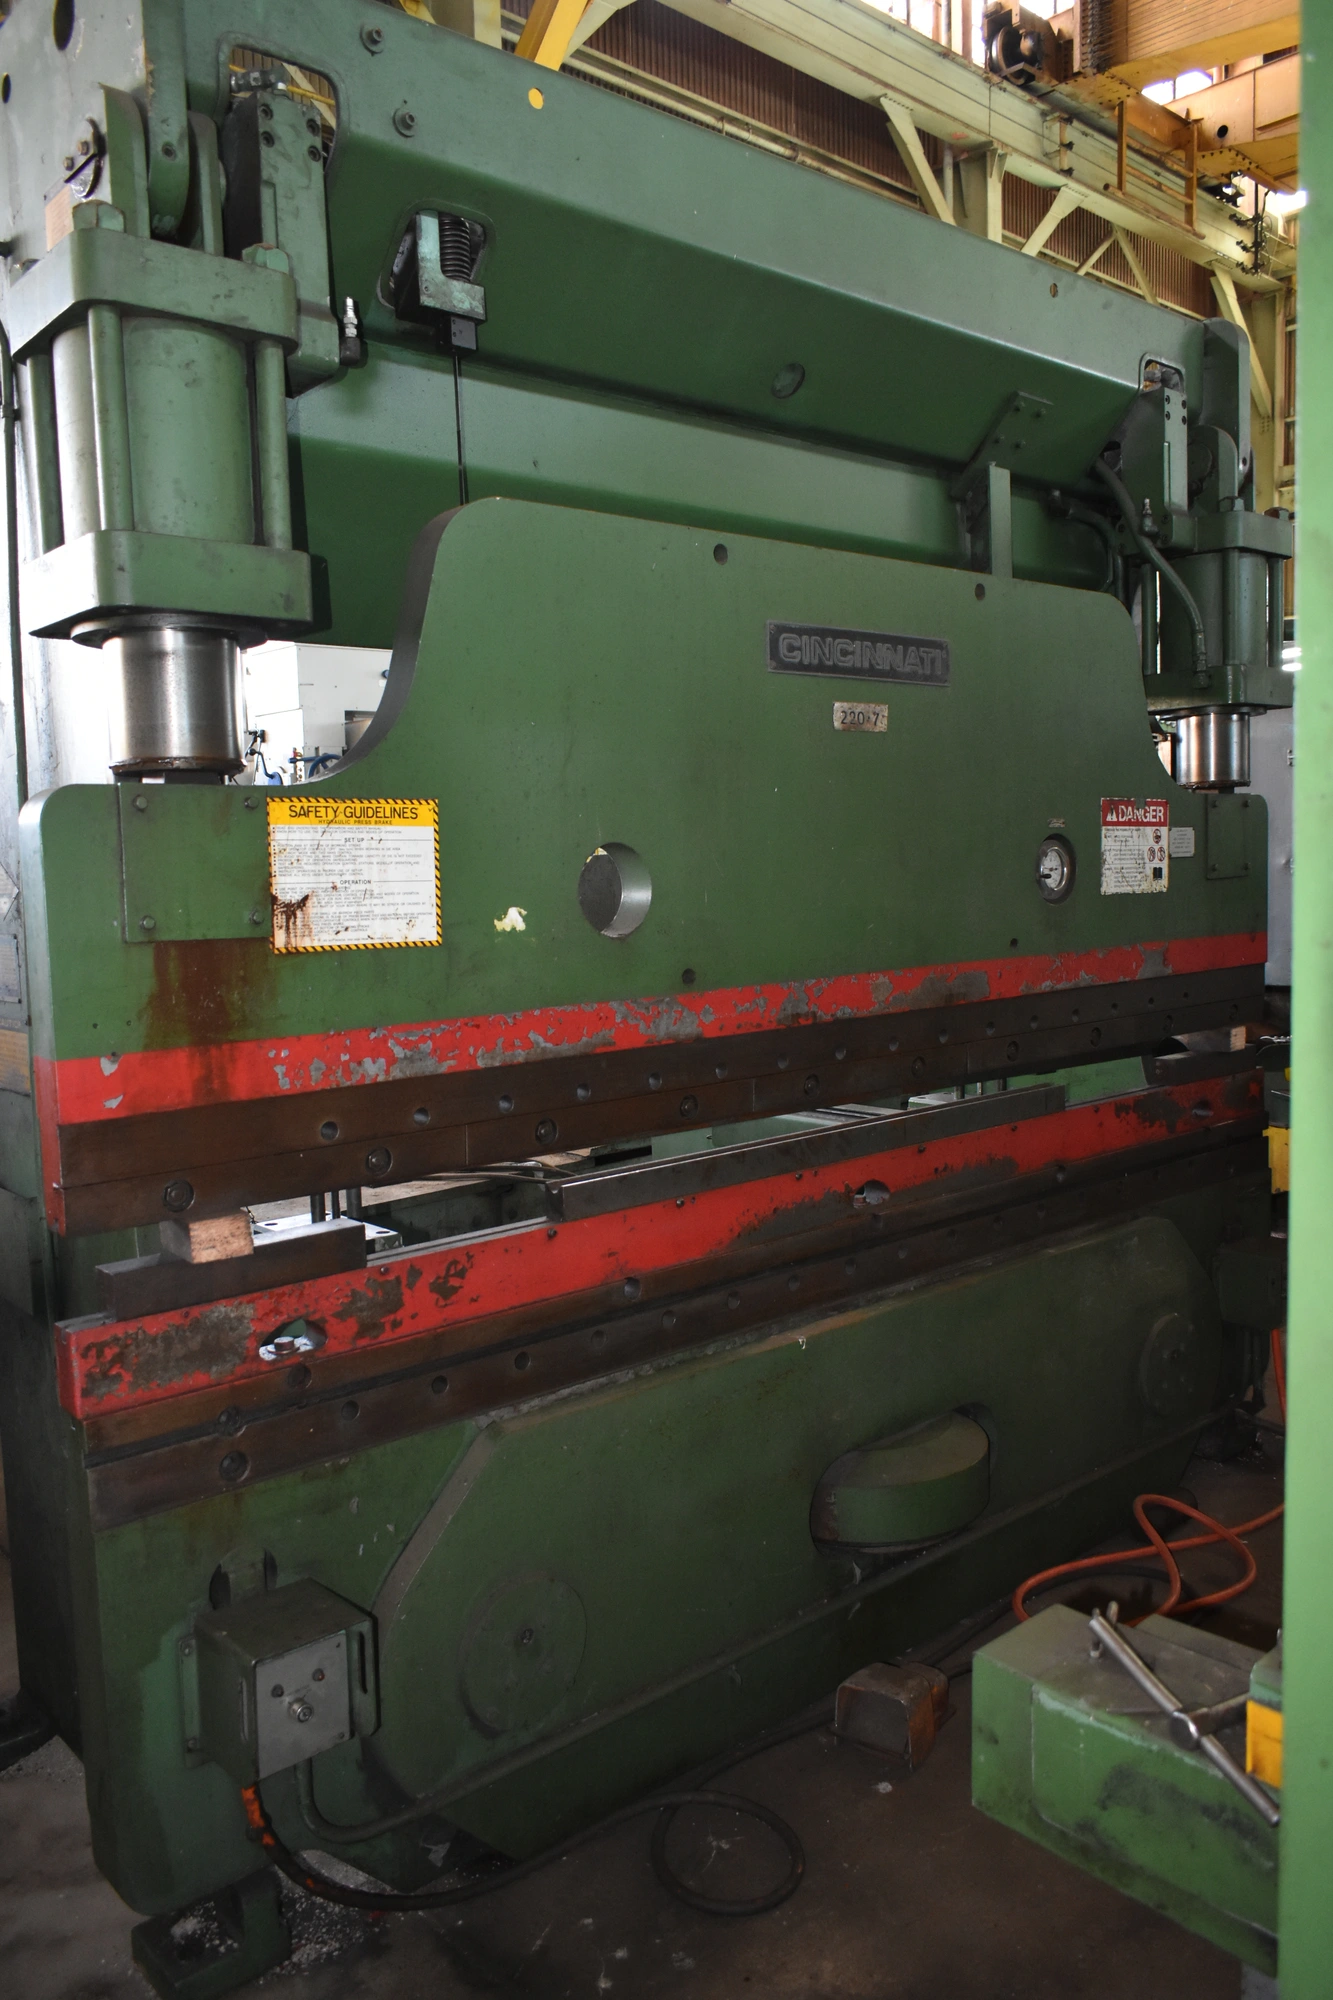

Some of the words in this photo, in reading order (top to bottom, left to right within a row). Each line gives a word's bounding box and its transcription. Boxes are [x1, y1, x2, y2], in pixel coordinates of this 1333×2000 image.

[778, 632, 943, 675] CINCINNATI
[288, 804, 339, 819] SAFETY
[343, 805, 419, 820] GUIDELINES
[1118, 805, 1164, 822] DANGER
